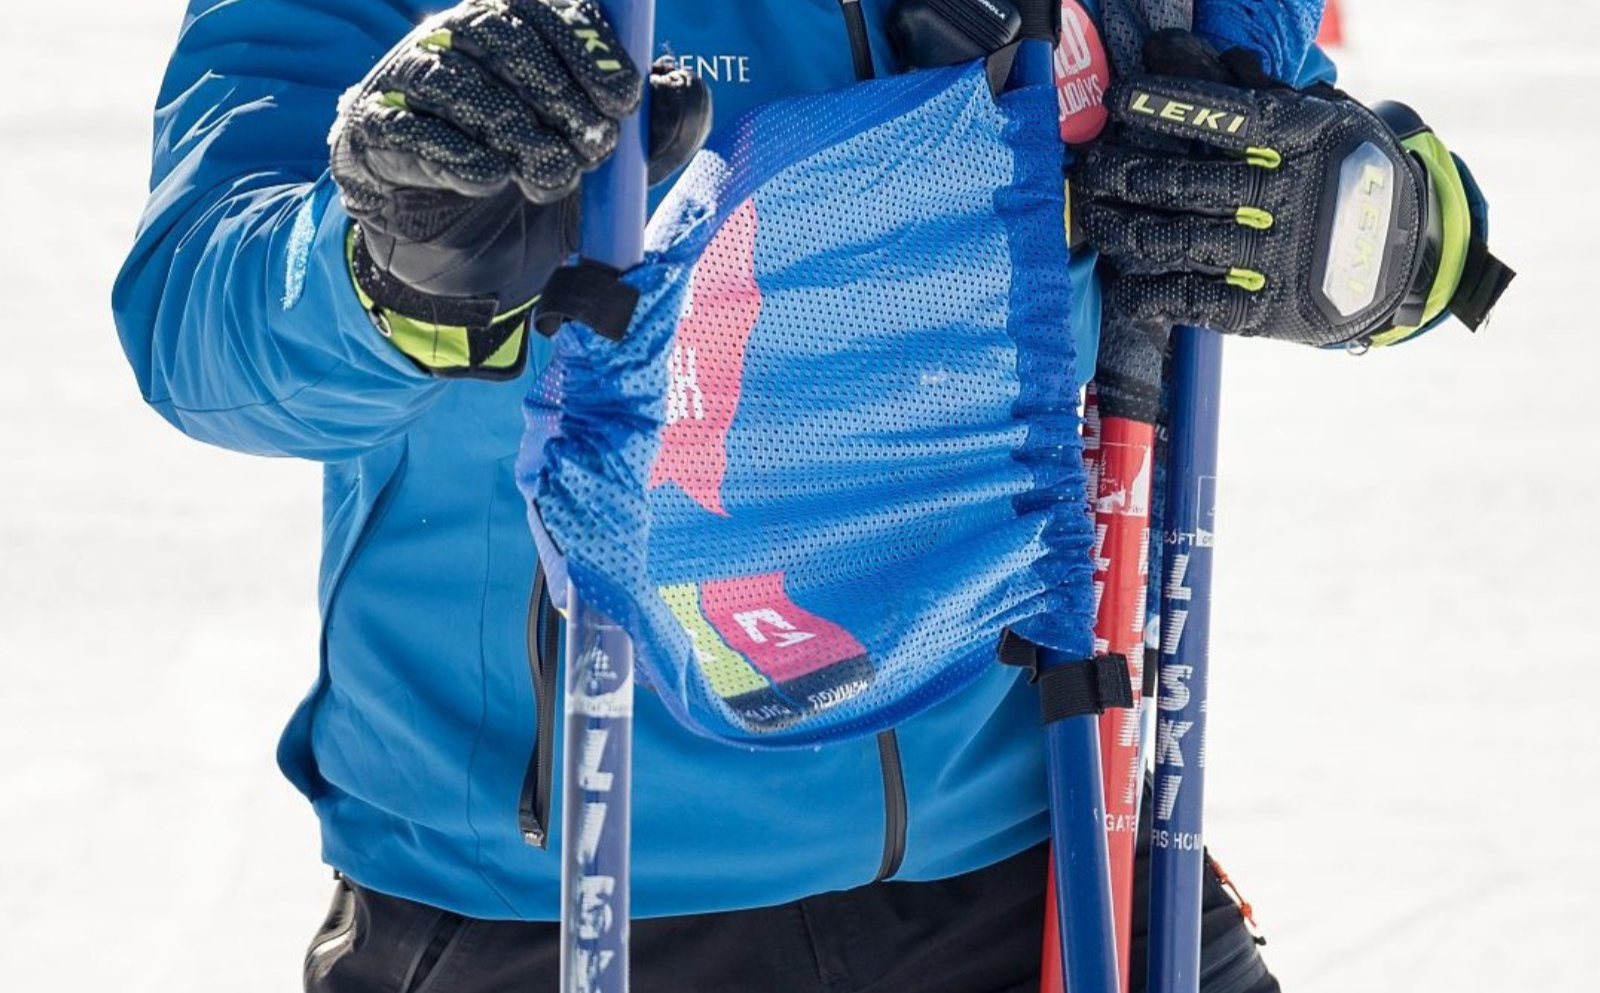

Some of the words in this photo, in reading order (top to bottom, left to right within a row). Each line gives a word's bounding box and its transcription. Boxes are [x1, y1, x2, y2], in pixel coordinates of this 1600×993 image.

[1132, 93, 1245, 133] LEKI
[1347, 164, 1385, 295] LEKI
[1156, 553, 1194, 820] LISKI
